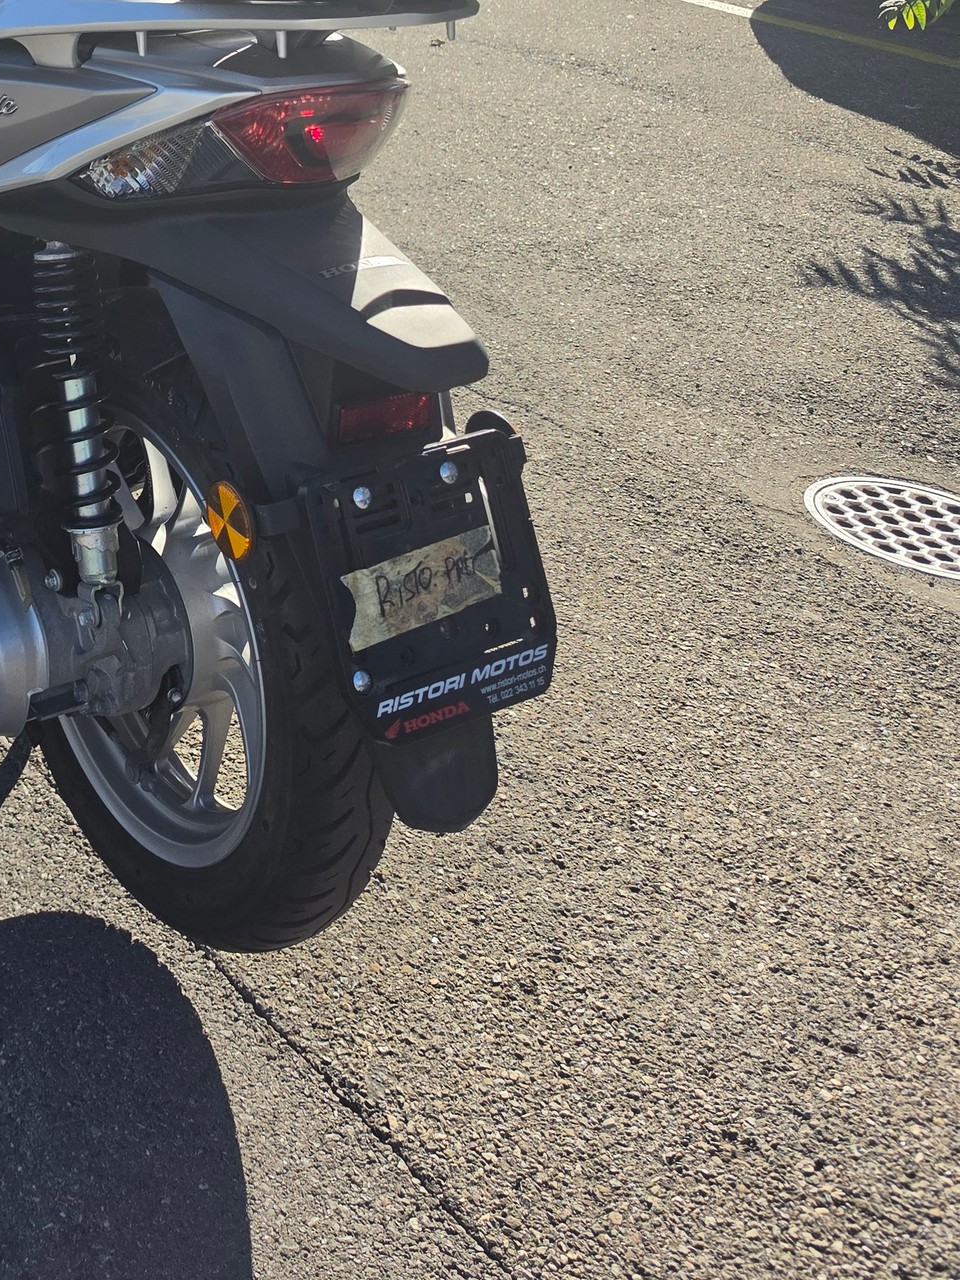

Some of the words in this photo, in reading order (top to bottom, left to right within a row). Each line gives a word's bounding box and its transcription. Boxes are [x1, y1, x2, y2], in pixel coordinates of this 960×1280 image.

[377, 673, 467, 718] RISTORI
[470, 644, 548, 684] MOTOS
[480, 665, 546, 694] www.ristori-motos.ch
[500, 688, 513, 699] 022
[536, 676, 545, 686] 15
[404, 701, 470, 733] HONDA
